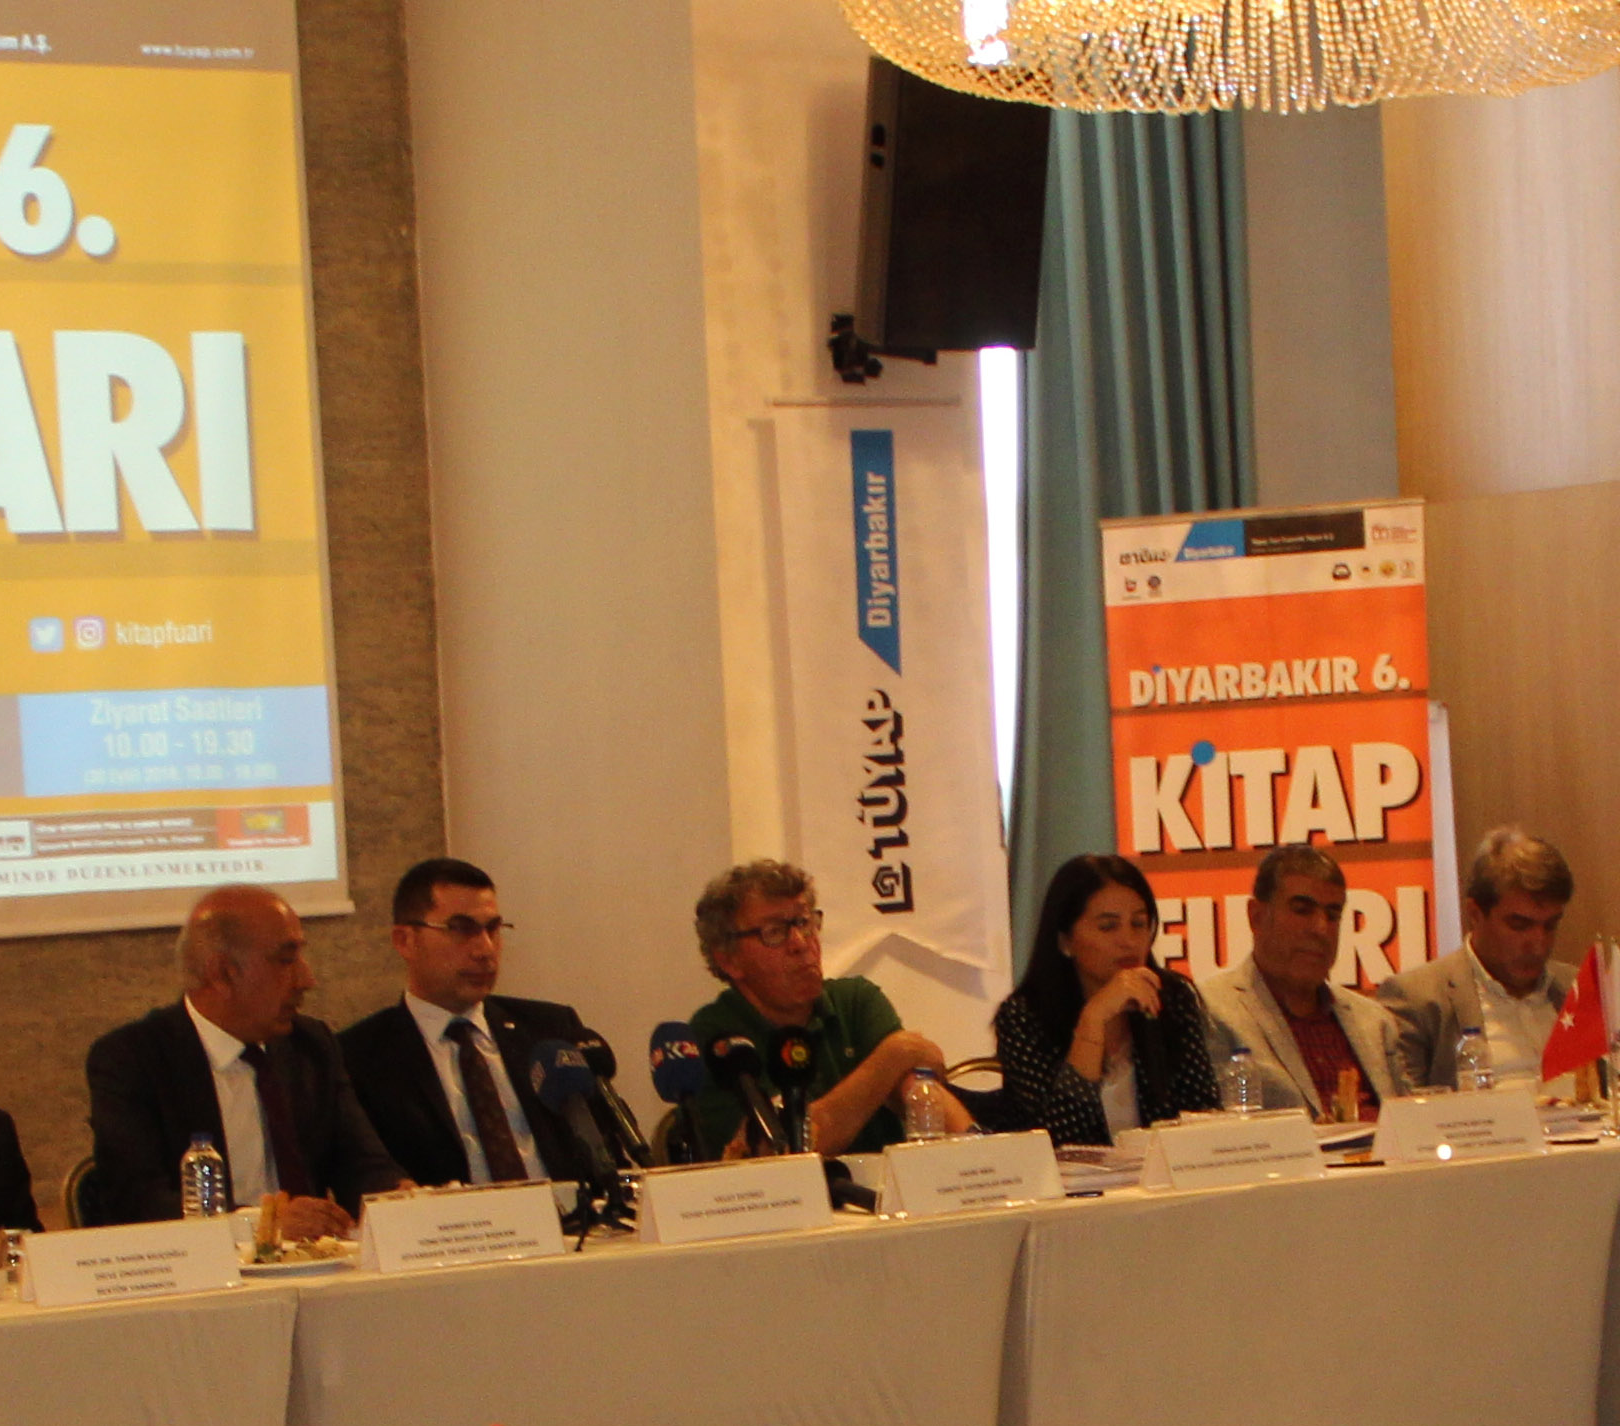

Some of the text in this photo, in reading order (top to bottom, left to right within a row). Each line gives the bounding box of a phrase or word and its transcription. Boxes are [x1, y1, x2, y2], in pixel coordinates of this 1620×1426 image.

[860, 471, 898, 630] Diyarbakır
[115, 620, 213, 648] kitapfuari
[1129, 653, 1411, 708] DİYARBAKIR 6.
[857, 686, 911, 862] TÜYAP
[1129, 740, 1422, 854] KİTAP
[1154, 885, 1432, 986] FURI
